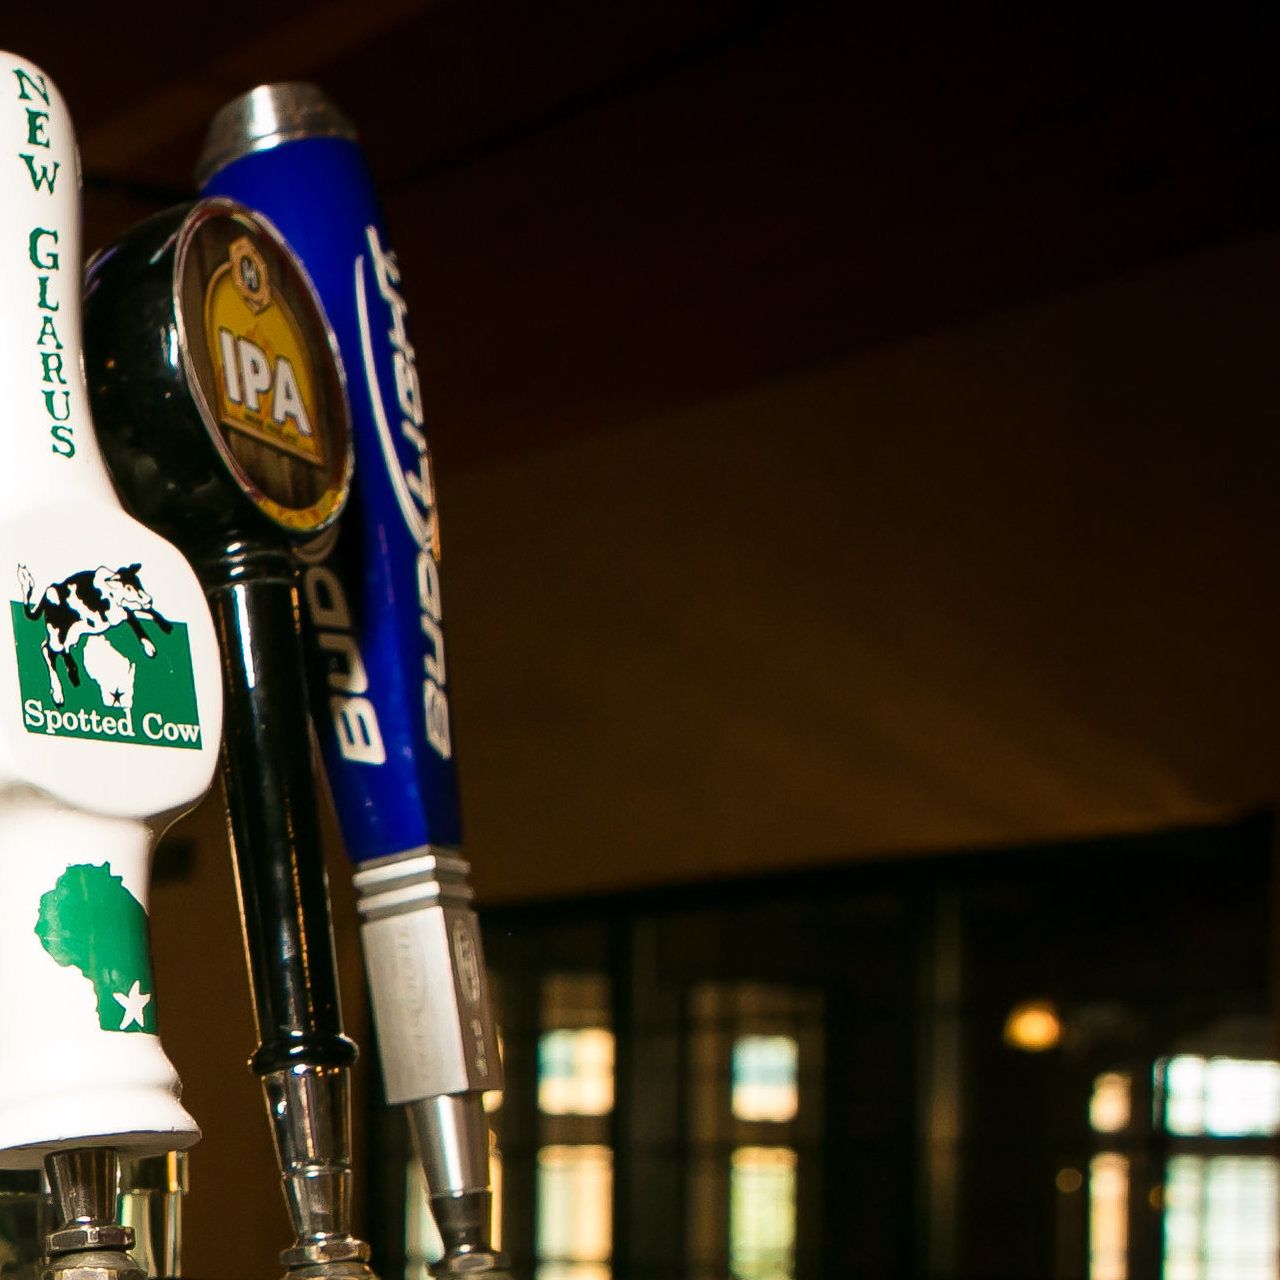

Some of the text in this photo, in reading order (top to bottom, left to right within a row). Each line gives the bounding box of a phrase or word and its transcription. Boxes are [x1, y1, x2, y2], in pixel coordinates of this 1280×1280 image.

[12, 67, 76, 459] NEW GLARUS
[218, 326, 314, 438] IPA
[24, 699, 201, 744] Spotted Cow
[302, 564, 388, 766] BUD
[416, 550, 452, 761] BUD
